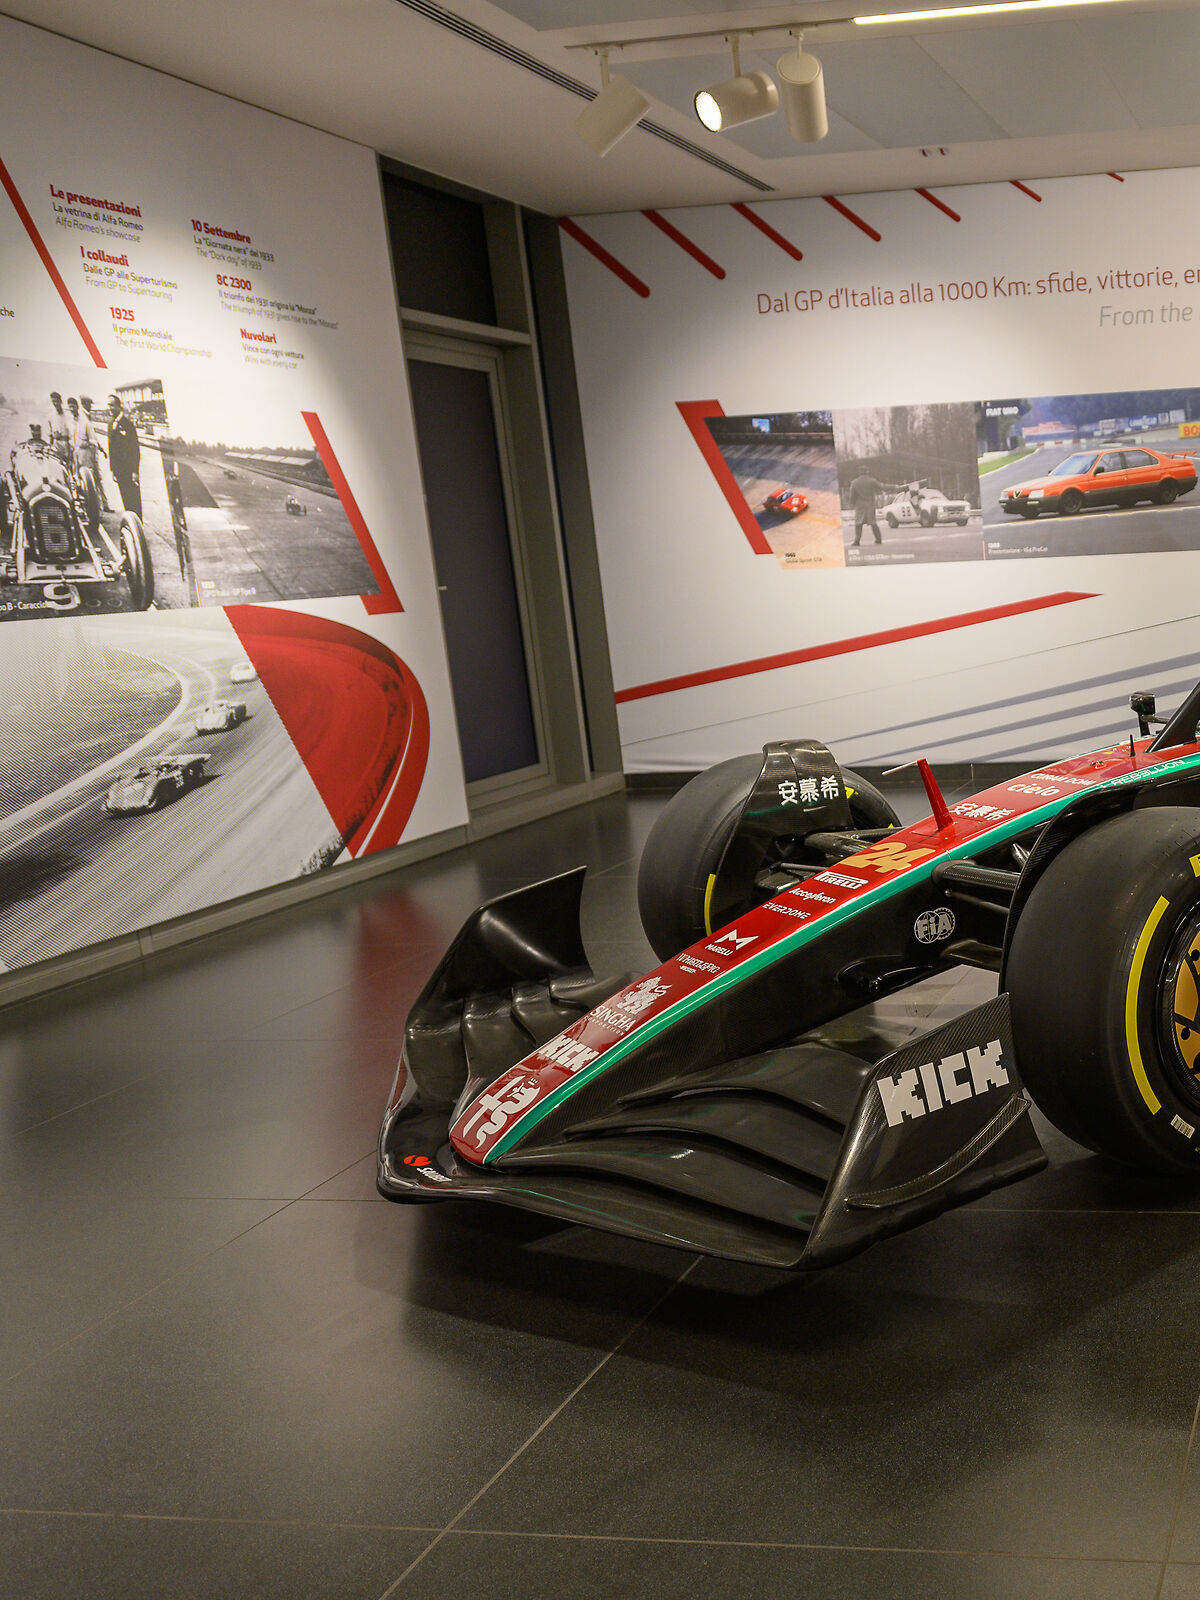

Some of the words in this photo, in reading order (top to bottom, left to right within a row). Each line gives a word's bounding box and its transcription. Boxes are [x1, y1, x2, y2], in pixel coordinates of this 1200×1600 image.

[49, 184, 65, 199] Le
[66, 191, 142, 217] presentazioni
[52, 201, 62, 213] La
[64, 206, 92, 219] vetrina
[93, 210, 101, 221] di
[102, 213, 117, 225] Alfa
[118, 217, 144, 231] Romeo
[55, 216, 72, 230] Alfa
[73, 219, 105, 235] Romeo's
[106, 228, 141, 243] showcase
[191, 219, 202, 232] 10
[203, 222, 252, 244] Settembre
[80, 245, 86, 258] I
[86, 249, 129, 266] collaudi
[83, 262, 103, 275] Dalle
[104, 267, 115, 276] GP
[116, 270, 129, 280] alle
[130, 272, 178, 289] Superturismo
[216, 274, 229, 286] 8C
[230, 277, 252, 291] 2300
[86, 276, 106, 288] From
[106, 280, 118, 290] GP
[127, 283, 173, 303] Supertouring
[757, 292, 789, 316] Dal
[794, 290, 824, 312] GP
[828, 285, 894, 310] d'Italia
[899, 282, 935, 305] alla
[938, 279, 988, 302] 1000
[993, 275, 1032, 299] Km:
[1035, 270, 1092, 296] sfide,
[1096, 265, 1179, 291] vittorie,
[109, 306, 135, 322] 1925
[1100, 304, 1154, 328] From
[1159, 301, 1194, 323] the
[119, 326, 140, 336] primo
[141, 328, 173, 340] Mondiale
[240, 328, 277, 344] Nuvolari
[242, 343, 259, 354] Vince
[43, 583, 81, 611] 9
[778, 775, 839, 806] 安慕希
[1007, 783, 1060, 797] cielo
[841, 842, 938, 874] 24
[814, 871, 869, 890] PIRELLI
[704, 943, 734, 957] MARELLI
[590, 1005, 637, 1032] SINGHA
[536, 1034, 600, 1073] KICK
[876, 1039, 1010, 1128] KICK
